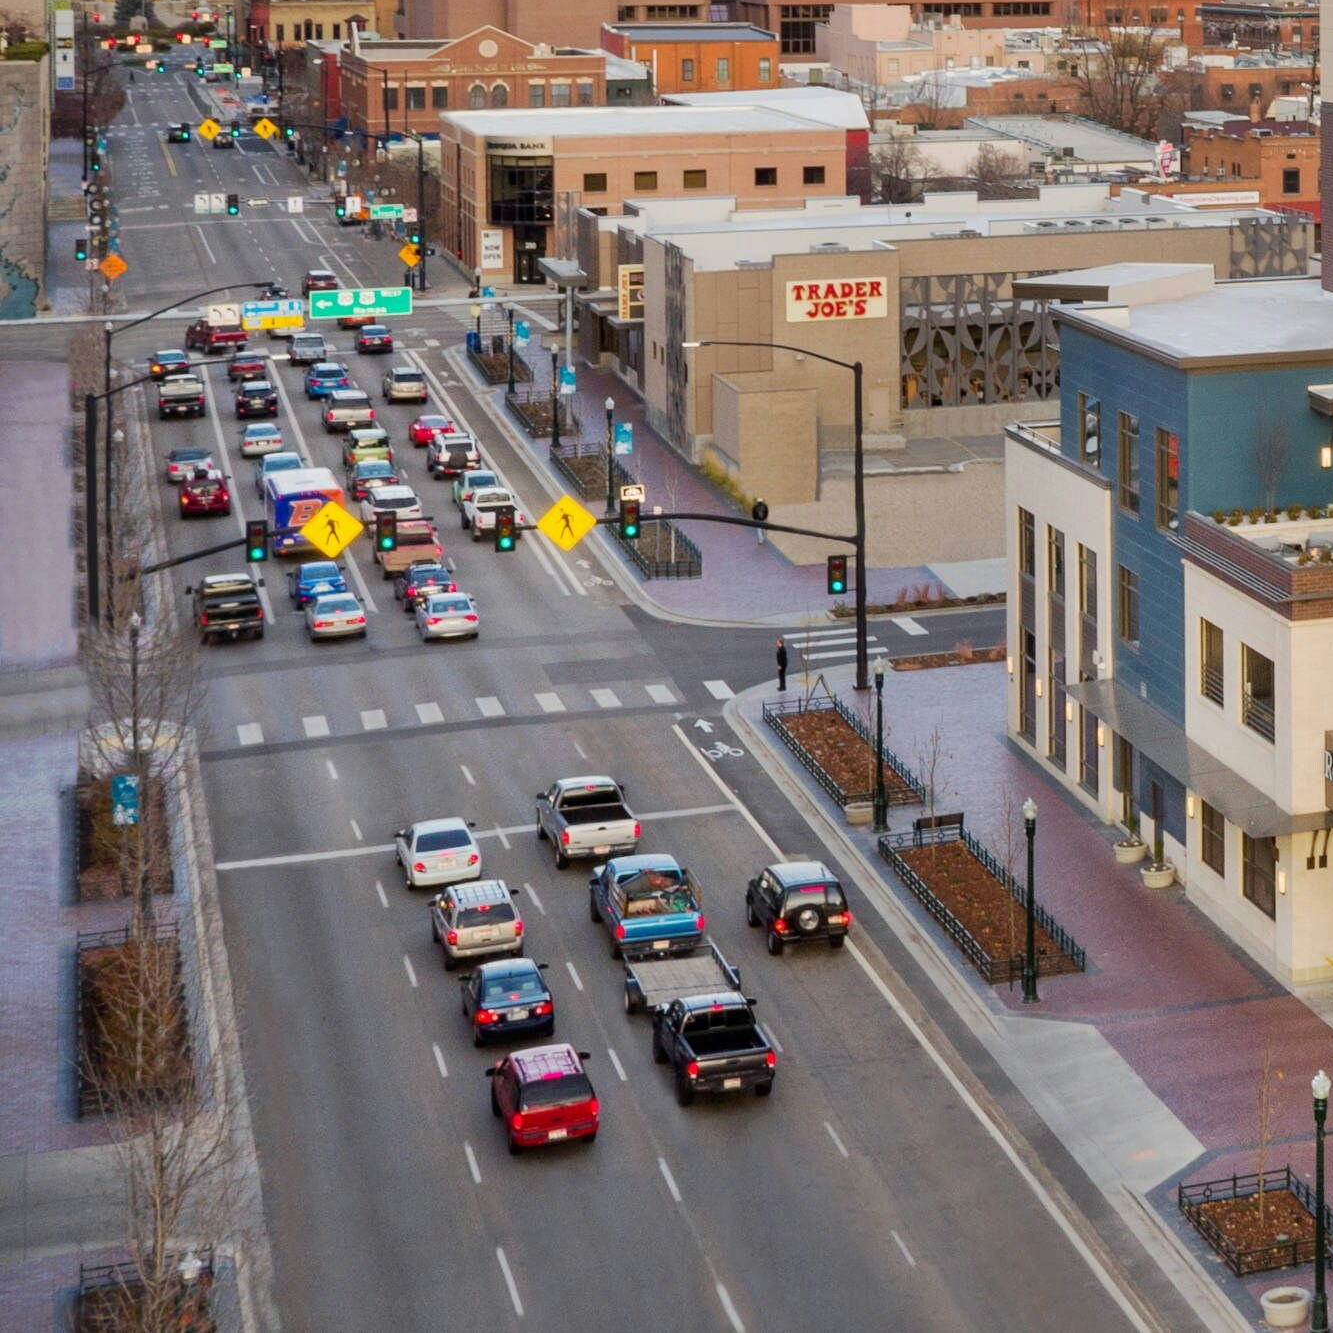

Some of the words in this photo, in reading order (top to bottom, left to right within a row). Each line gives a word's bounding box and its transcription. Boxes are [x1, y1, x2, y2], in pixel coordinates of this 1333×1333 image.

[520, 142, 546, 150] BANK
[792, 281, 882, 301] TRADER
[806, 299, 867, 318] JOE'S
